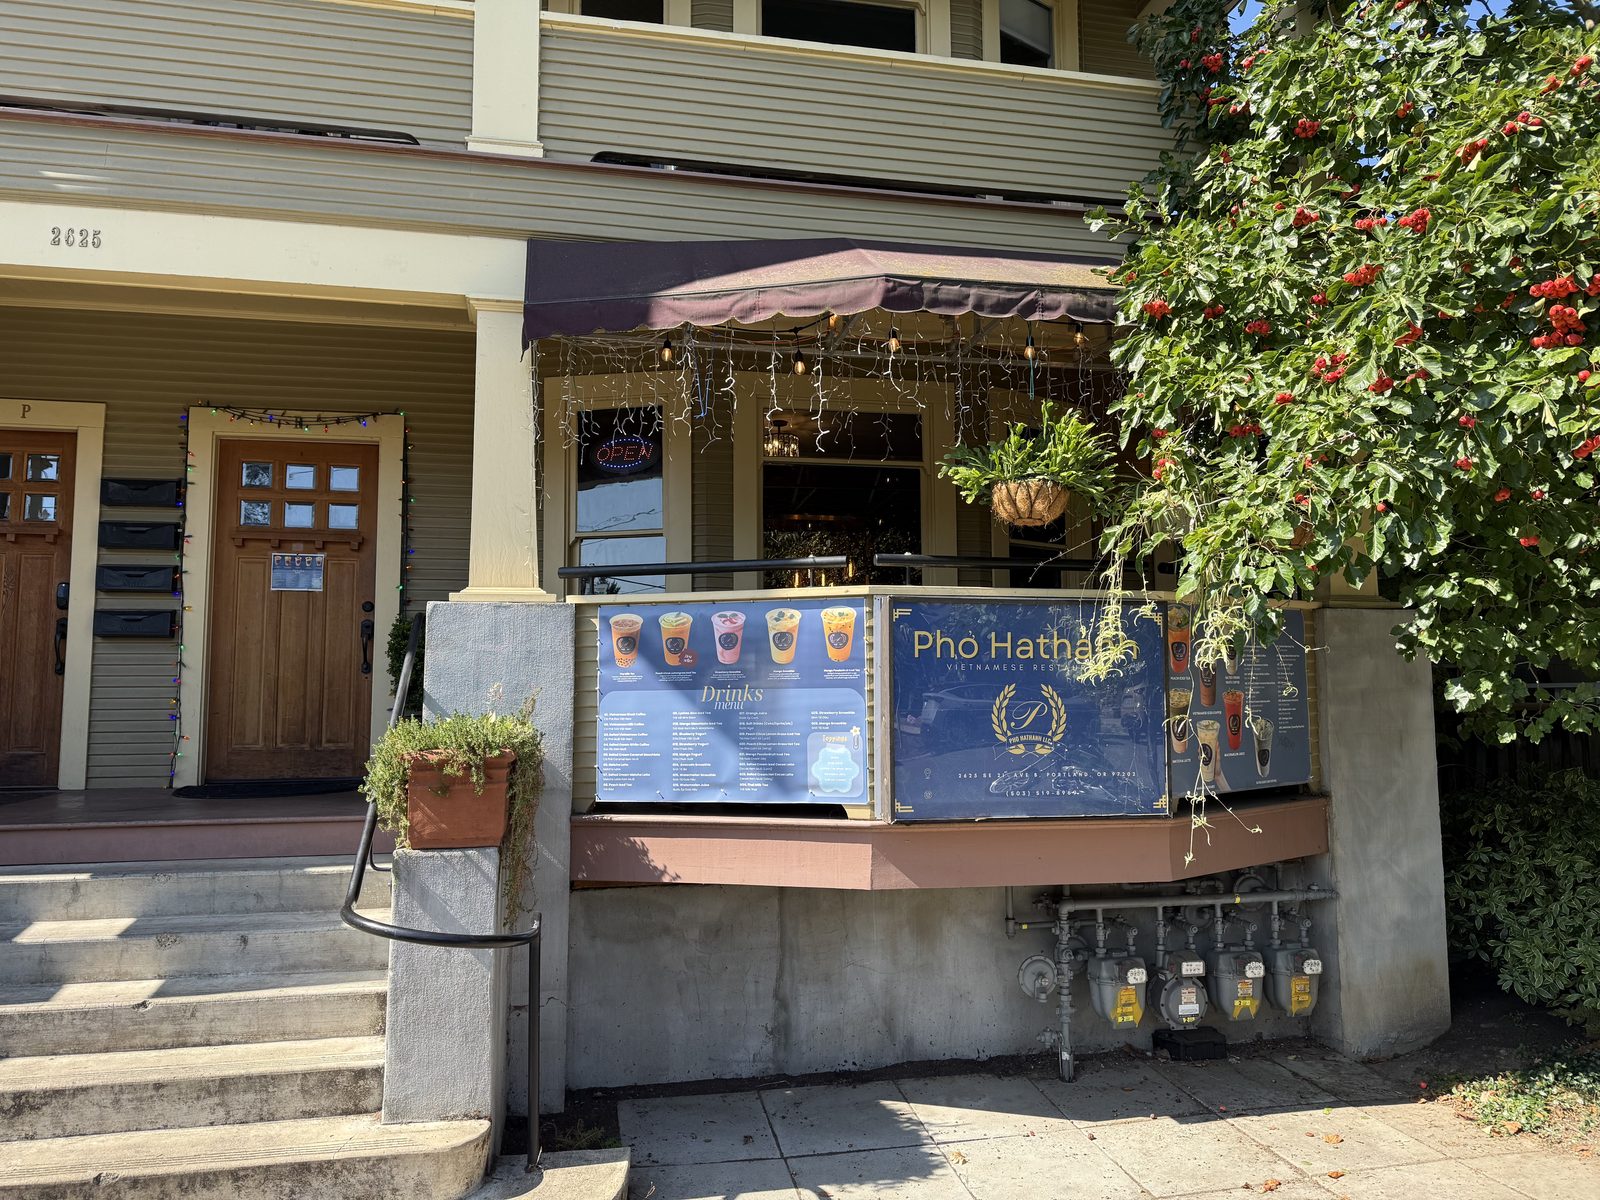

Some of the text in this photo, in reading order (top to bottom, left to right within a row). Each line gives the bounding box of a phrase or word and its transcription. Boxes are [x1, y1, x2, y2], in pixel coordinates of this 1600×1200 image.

[50, 226, 102, 249] 2625
[20, 404, 31, 419] P
[596, 445, 654, 462] OPEN
[991, 630, 1138, 659] Hatha
[946, 663, 1024, 671] VIETNAMESE
[702, 685, 764, 703] Drinks
[714, 700, 744, 710] menu
[1005, 790, 1030, 798] (503)
